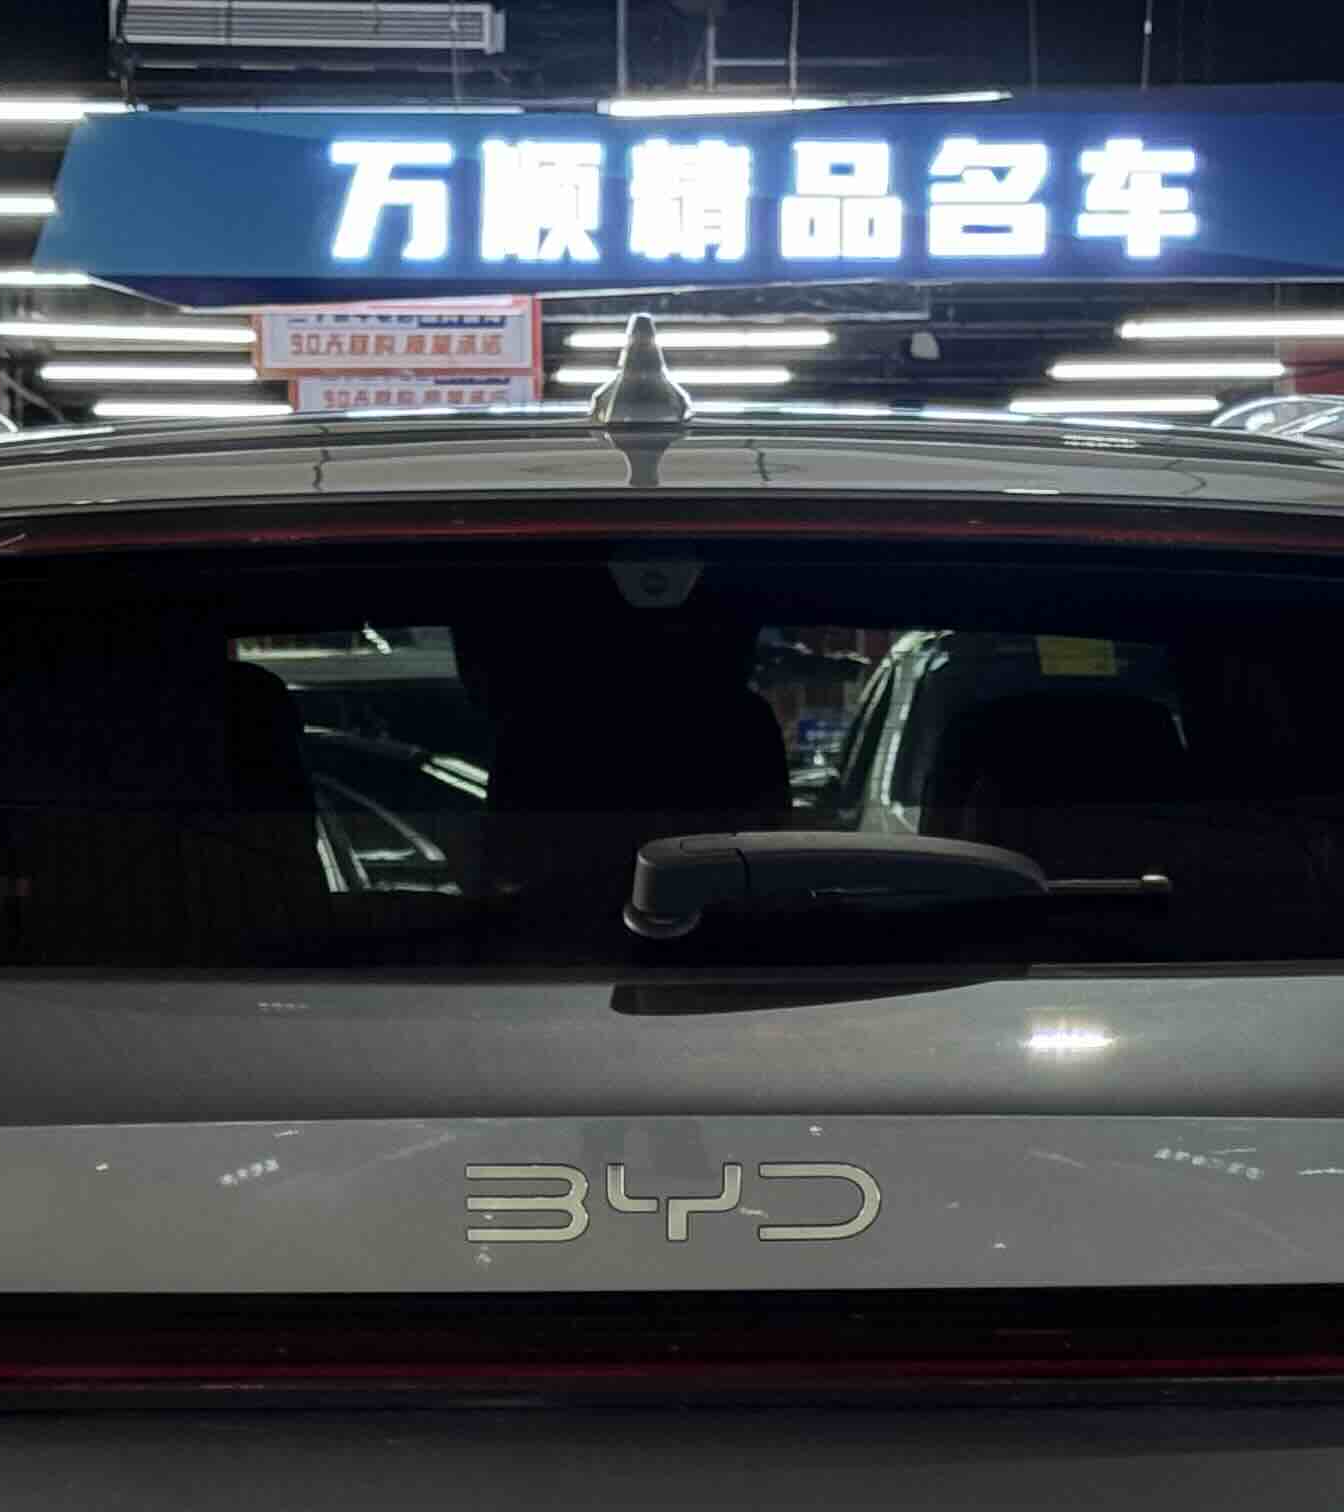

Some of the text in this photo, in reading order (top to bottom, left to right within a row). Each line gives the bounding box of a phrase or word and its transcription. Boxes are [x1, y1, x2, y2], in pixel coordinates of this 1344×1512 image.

[328, 137, 1200, 262] 万顺精品名车
[464, 1162, 882, 1243] BYD
